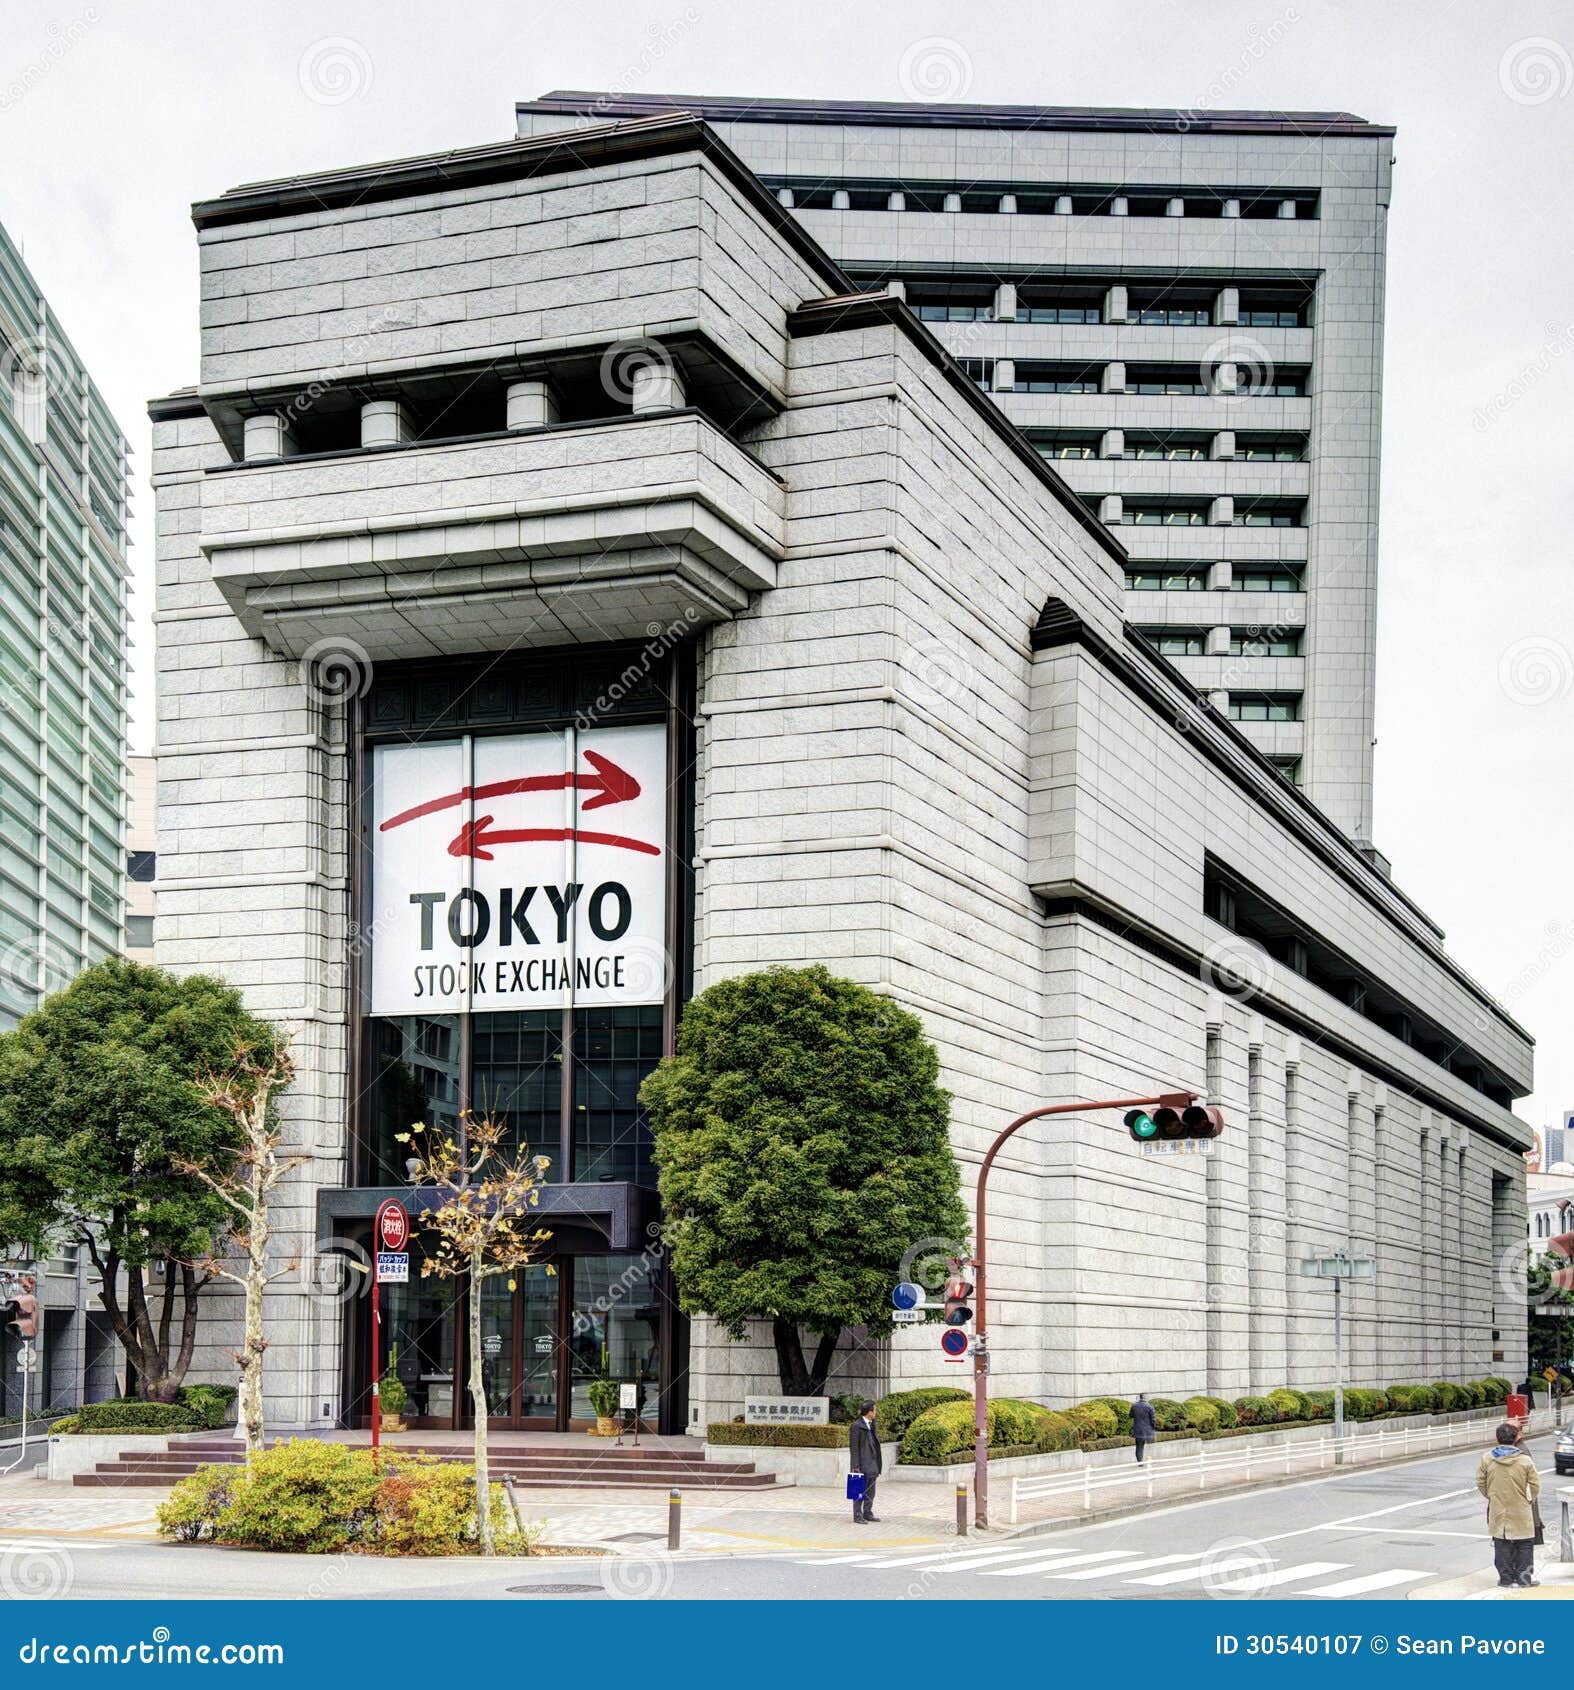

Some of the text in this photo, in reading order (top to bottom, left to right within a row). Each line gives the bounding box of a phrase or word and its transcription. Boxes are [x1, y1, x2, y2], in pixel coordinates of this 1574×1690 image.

[410, 881, 632, 950] TOKYO
[414, 955, 625, 997] STOCK EXCHANGE
[384, 1219, 402, 1235] 消火栓
